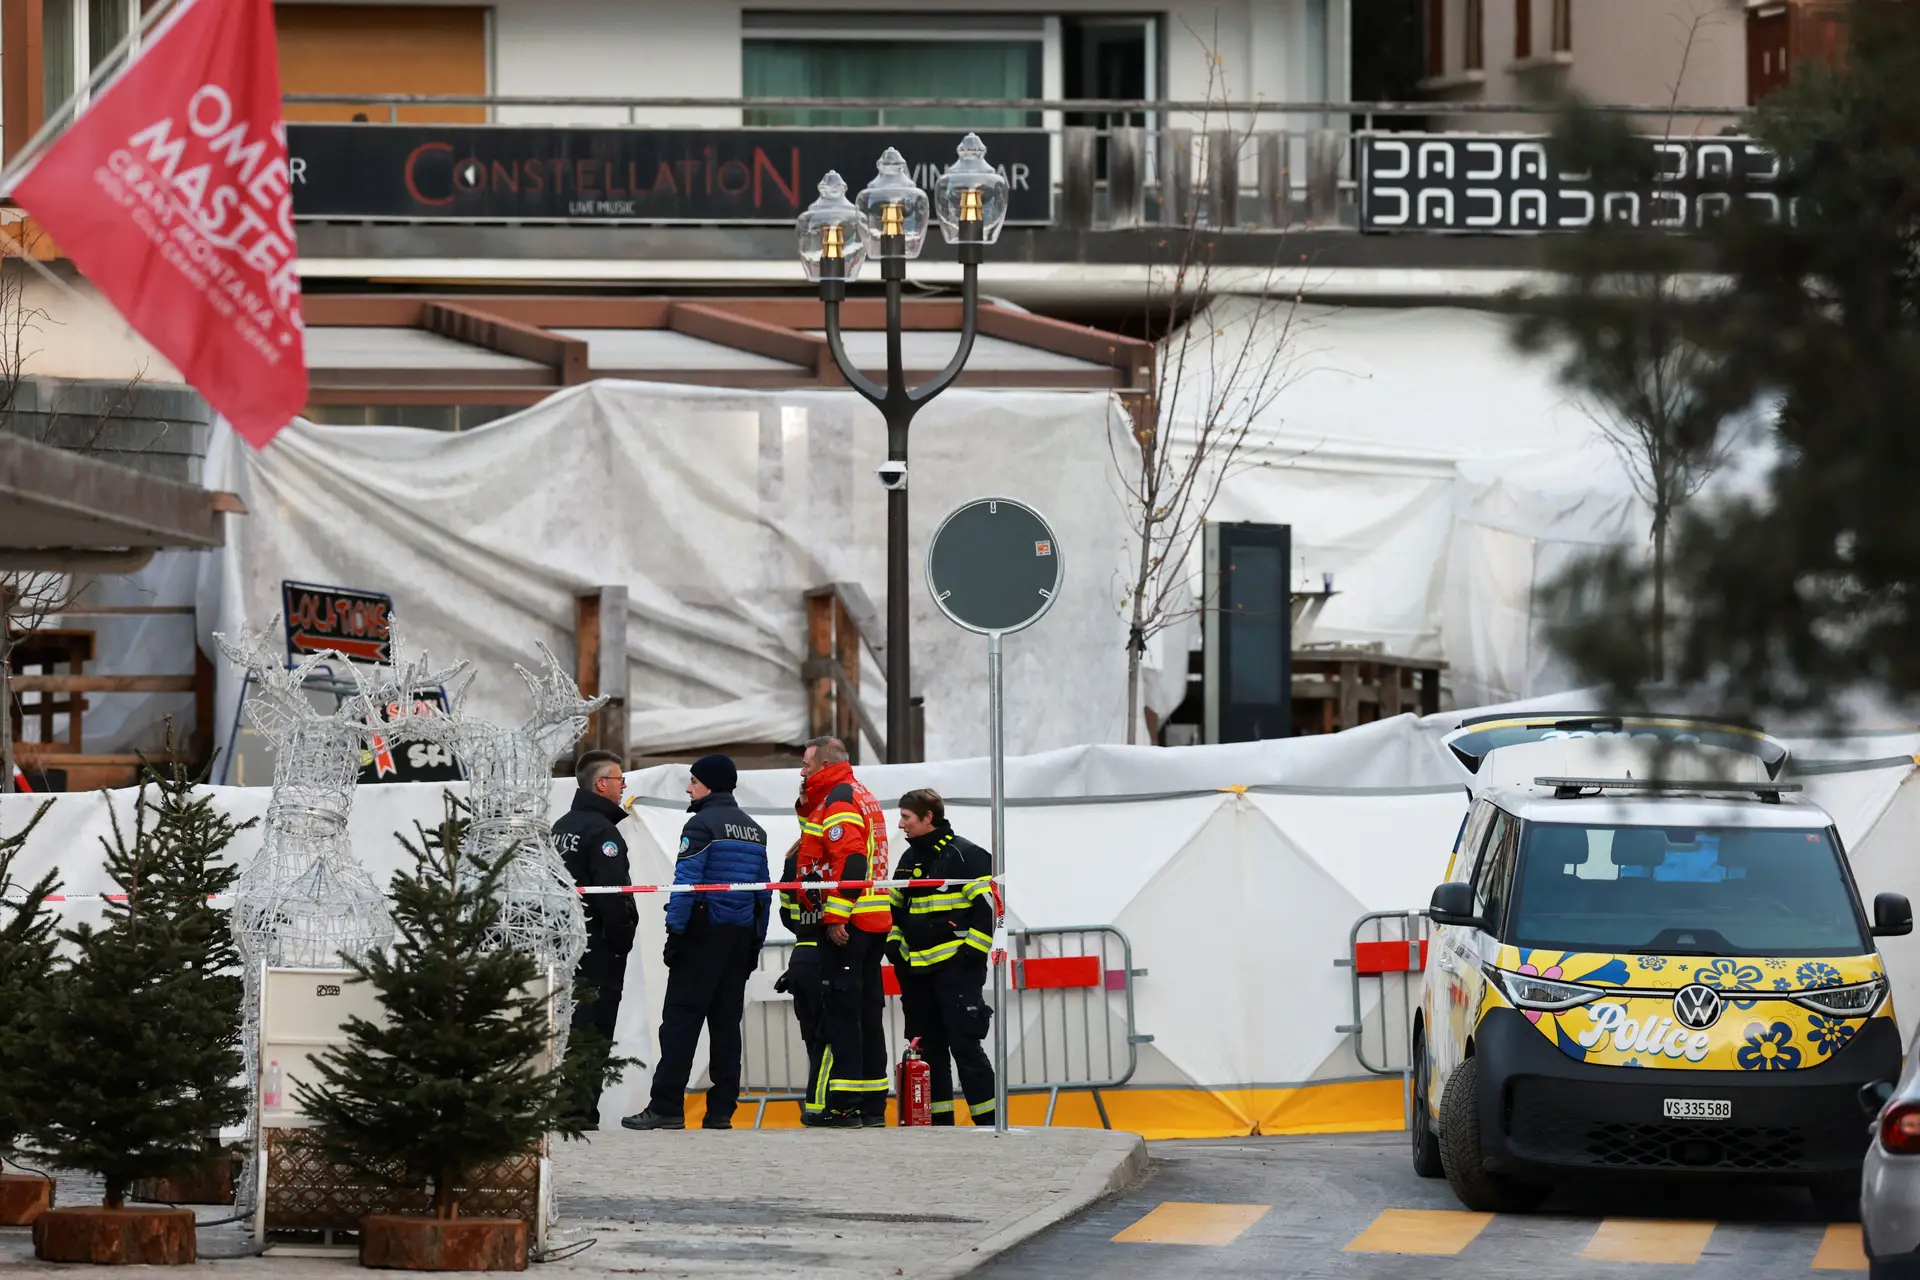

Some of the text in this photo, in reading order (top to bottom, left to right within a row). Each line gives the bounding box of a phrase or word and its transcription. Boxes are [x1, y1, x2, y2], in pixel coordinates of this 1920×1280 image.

[596, 201, 636, 215] MUSIC
[725, 823, 760, 842] POLICE
[1578, 1002, 1710, 1063] Police
